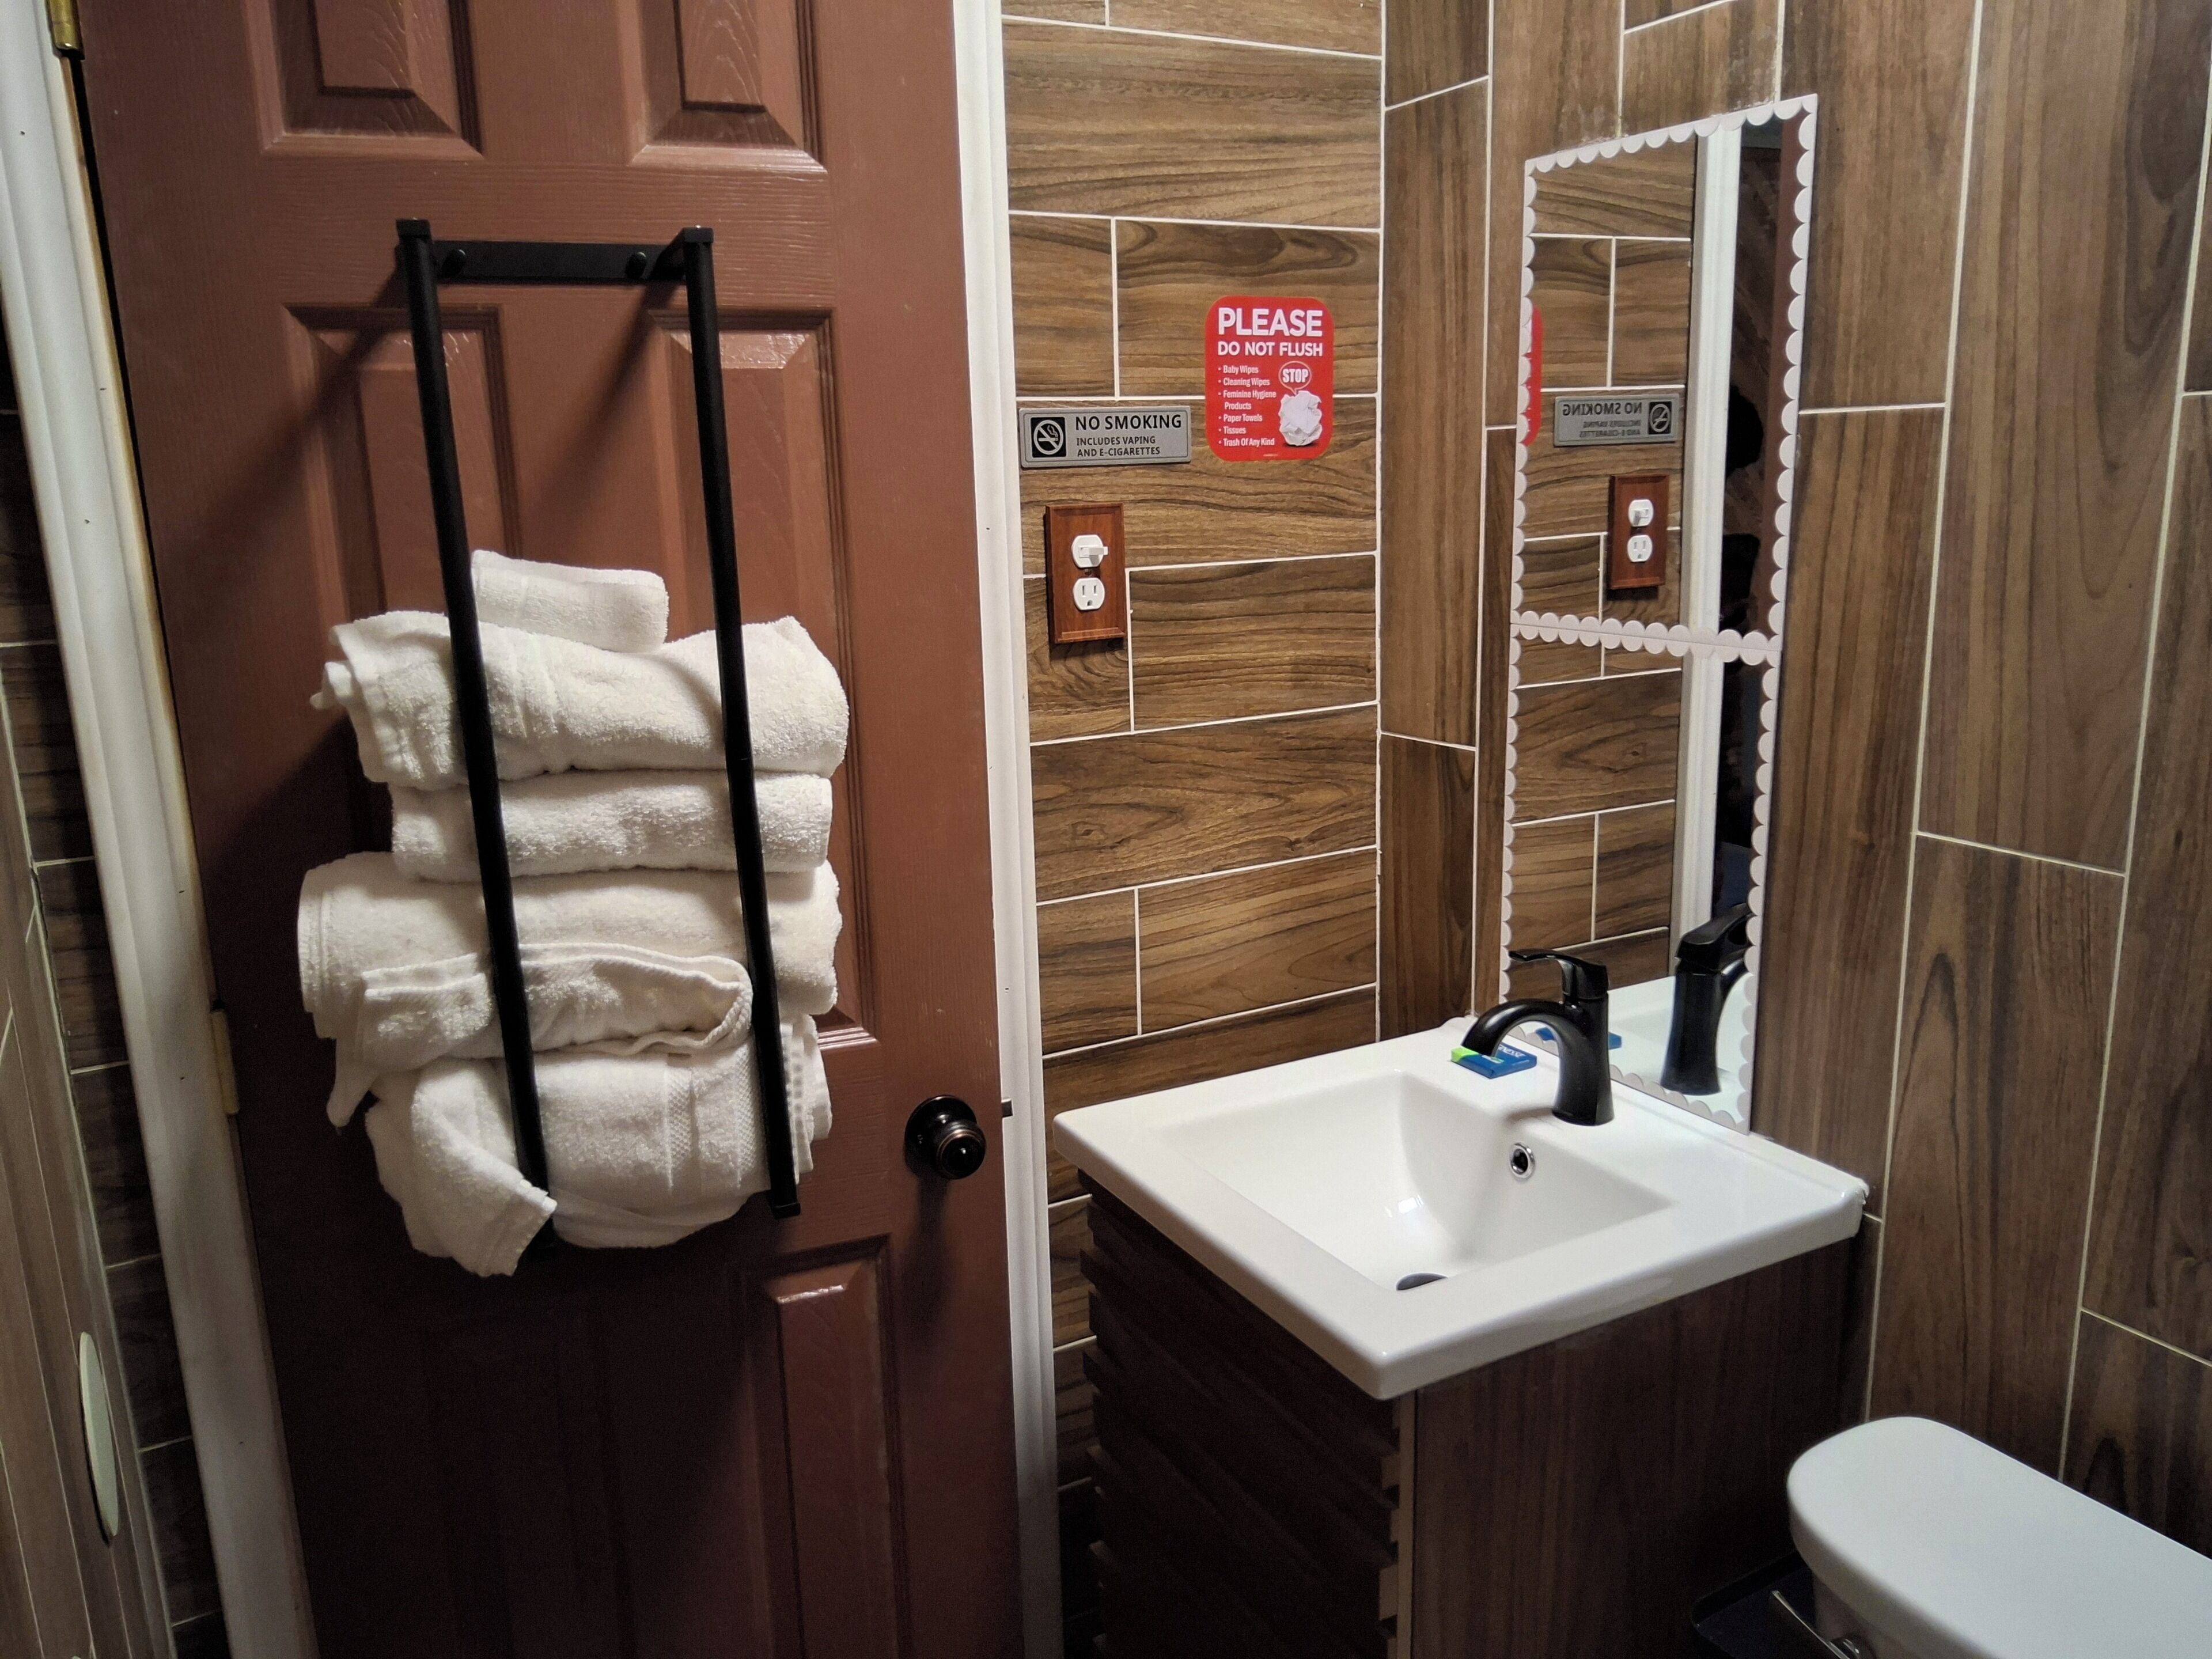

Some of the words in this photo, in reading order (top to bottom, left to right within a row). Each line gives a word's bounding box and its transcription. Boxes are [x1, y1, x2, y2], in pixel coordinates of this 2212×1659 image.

[1218, 307, 1323, 337] PLEASE
[1217, 341, 1240, 356] DO
[1245, 342, 1275, 356] NOT
[1279, 342, 1323, 357] FLUSH
[1223, 365, 1239, 375] Baby
[1240, 366, 1259, 374] Wipes
[1282, 369, 1309, 383] STOP
[1223, 377, 1251, 387] Cleaning
[1251, 378, 1270, 387] Wipes
[1223, 390, 1252, 398] Feminine
[1252, 391, 1277, 400] Hygiene
[1224, 402, 1252, 410] Products
[1075, 415, 1100, 430] NO
[1105, 414, 1182, 430] SMOKING
[1223, 414, 1241, 423] Paper
[1242, 414, 1263, 422] Towels
[1223, 426, 1247, 434] Tissues
[1076, 437, 1120, 446] INCLUDES
[1122, 436, 1156, 445] VAPING
[1223, 438, 1240, 446] Trash
[1241, 438, 1248, 446] Of
[1249, 438, 1260, 448] Any
[1261, 437, 1275, 445] Kind
[1077, 448, 1097, 457] AND
[1099, 446, 1160, 457] E-CIGARETTES
